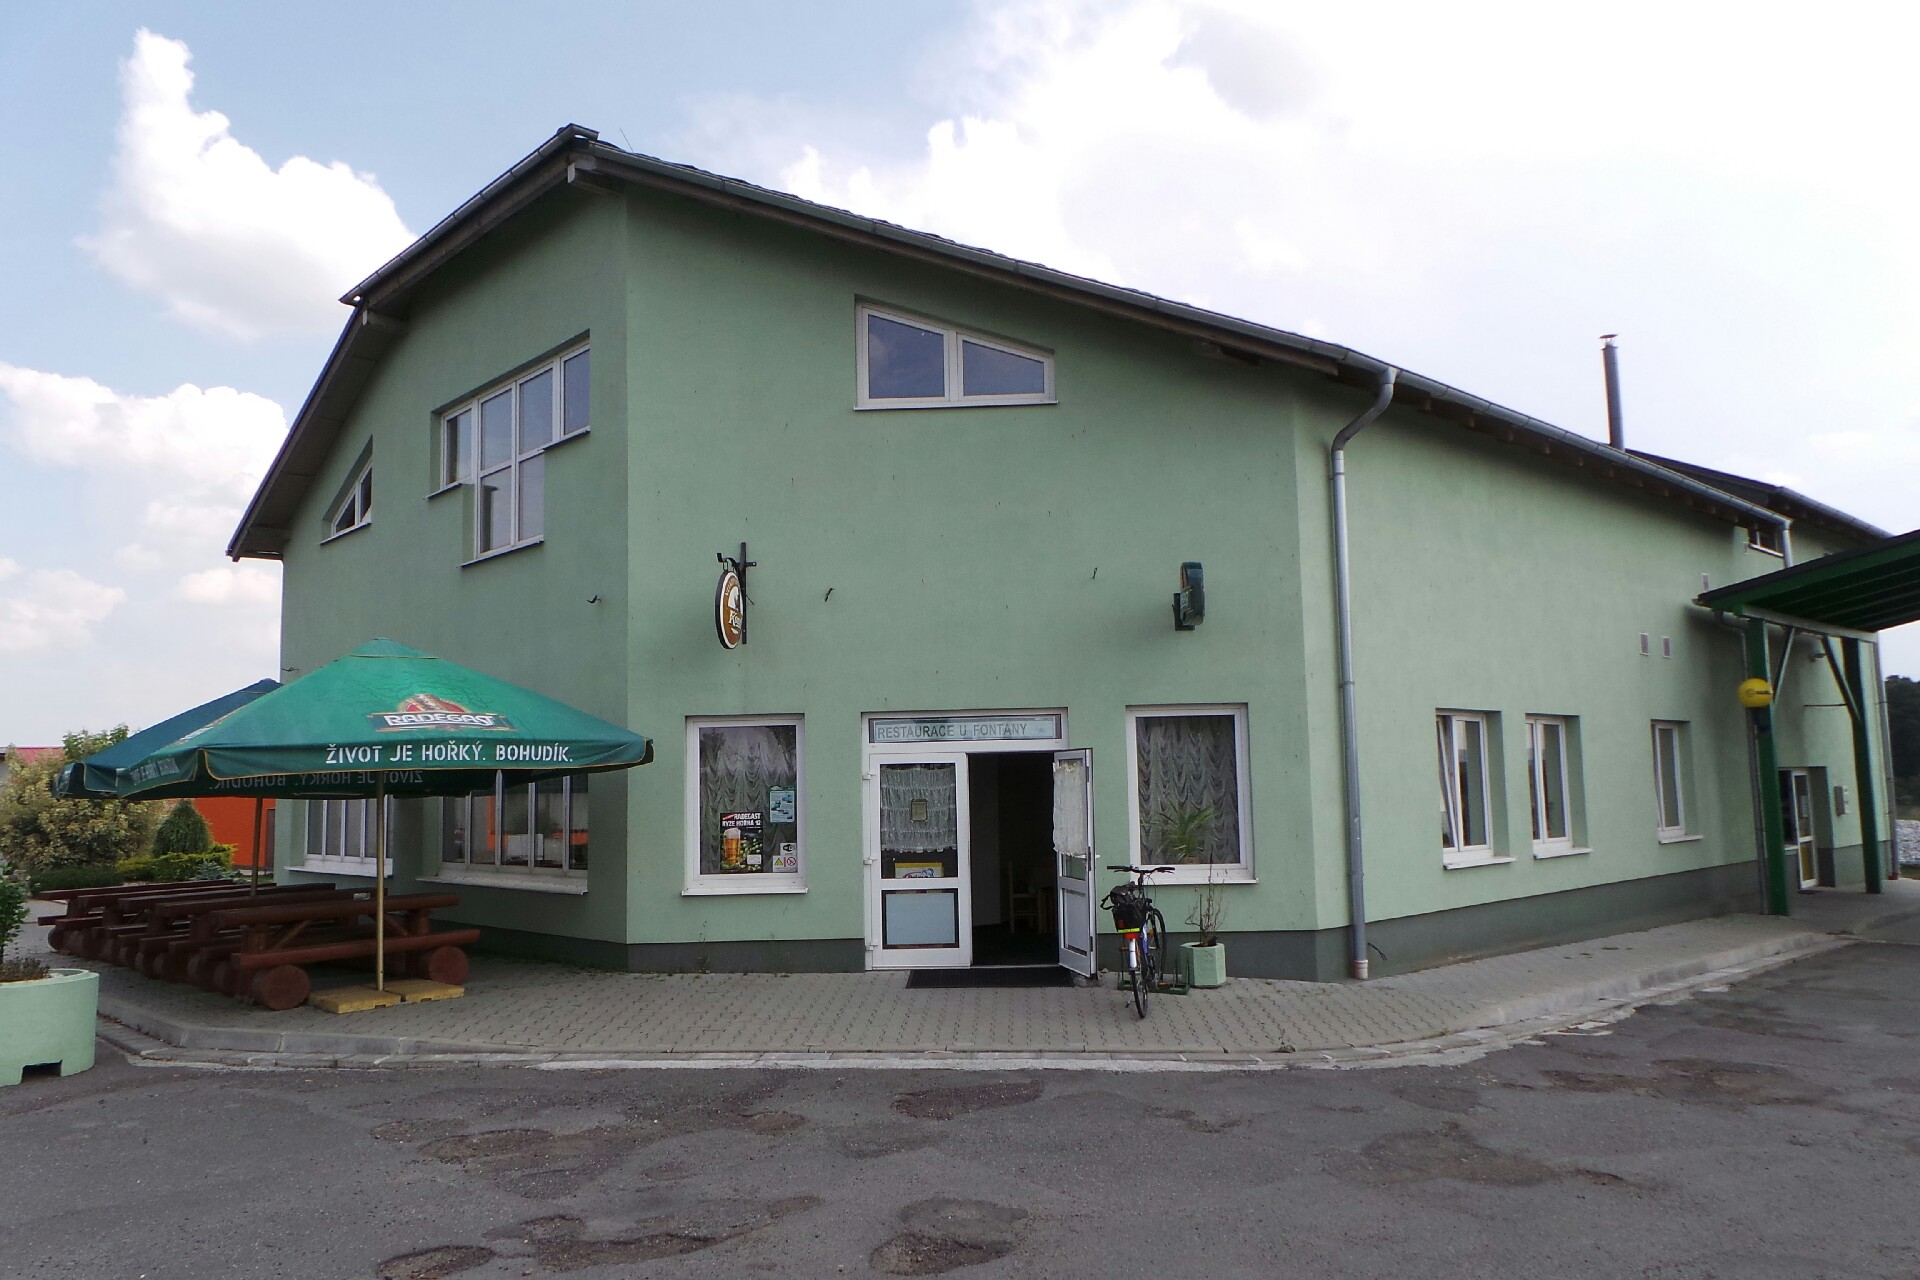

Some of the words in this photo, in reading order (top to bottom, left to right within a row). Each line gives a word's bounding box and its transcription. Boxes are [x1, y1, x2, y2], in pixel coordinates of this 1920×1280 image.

[384, 714, 495, 727] RADEGAST
[877, 722, 955, 739] RESTAURACE
[959, 723, 967, 737] U
[326, 743, 383, 764] ŽIVOT
[389, 744, 413, 762] JE
[422, 740, 486, 762] HOŘKÝ.
[495, 742, 573, 763] BOHUDÍK.
